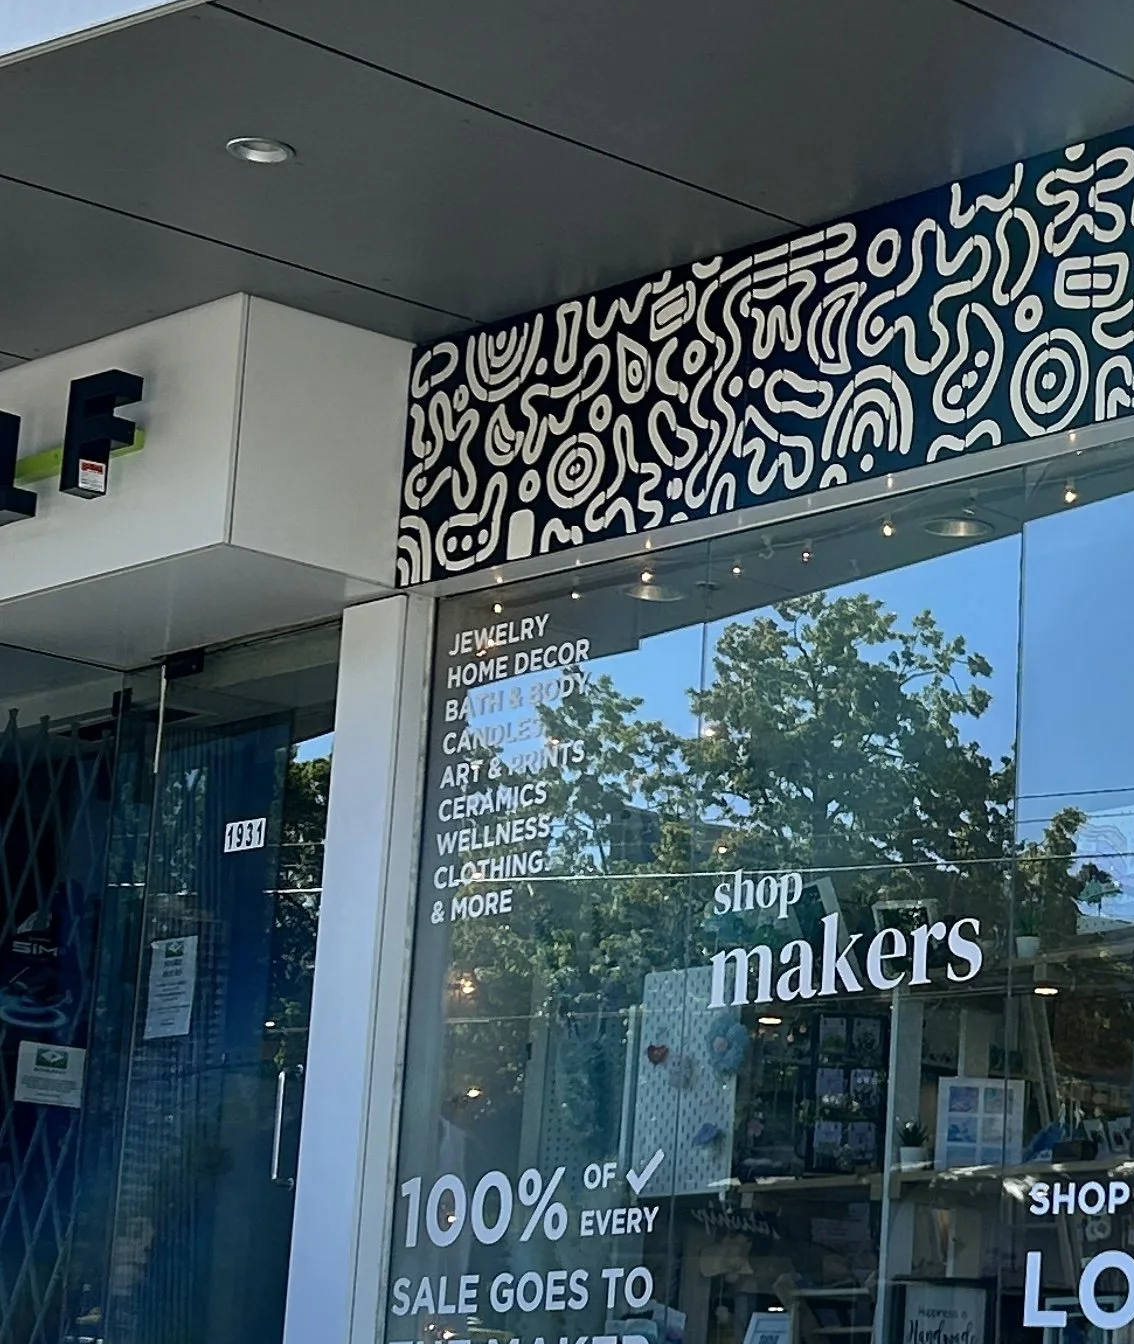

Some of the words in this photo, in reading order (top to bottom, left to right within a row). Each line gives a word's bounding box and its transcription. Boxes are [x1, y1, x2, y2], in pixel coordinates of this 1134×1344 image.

[449, 613, 550, 656] JEWELRY
[447, 656, 508, 689] HOME
[514, 638, 590, 675] DECOR
[445, 688, 504, 722] BATH
[530, 672, 592, 706] BODY
[443, 717, 546, 755] CANDLES
[440, 760, 483, 789] ART
[488, 756, 502, 779] &
[508, 740, 585, 776] PRINTS
[438, 781, 547, 822] CERAMICS
[227, 820, 263, 850] 1931
[436, 815, 551, 856] WELLNESS
[434, 850, 545, 889] CLOTHING
[431, 901, 444, 924] &
[451, 888, 513, 922] MORE
[713, 868, 803, 919] shop
[708, 913, 983, 1010] makers
[401, 1167, 568, 1248] 100%
[583, 1162, 617, 1191] OF
[1029, 1181, 1131, 1216] SHOP
[580, 1206, 659, 1237] EVERY
[391, 1273, 481, 1316] SALE
[490, 1269, 588, 1313] GOES
[602, 1266, 653, 1309] TO
